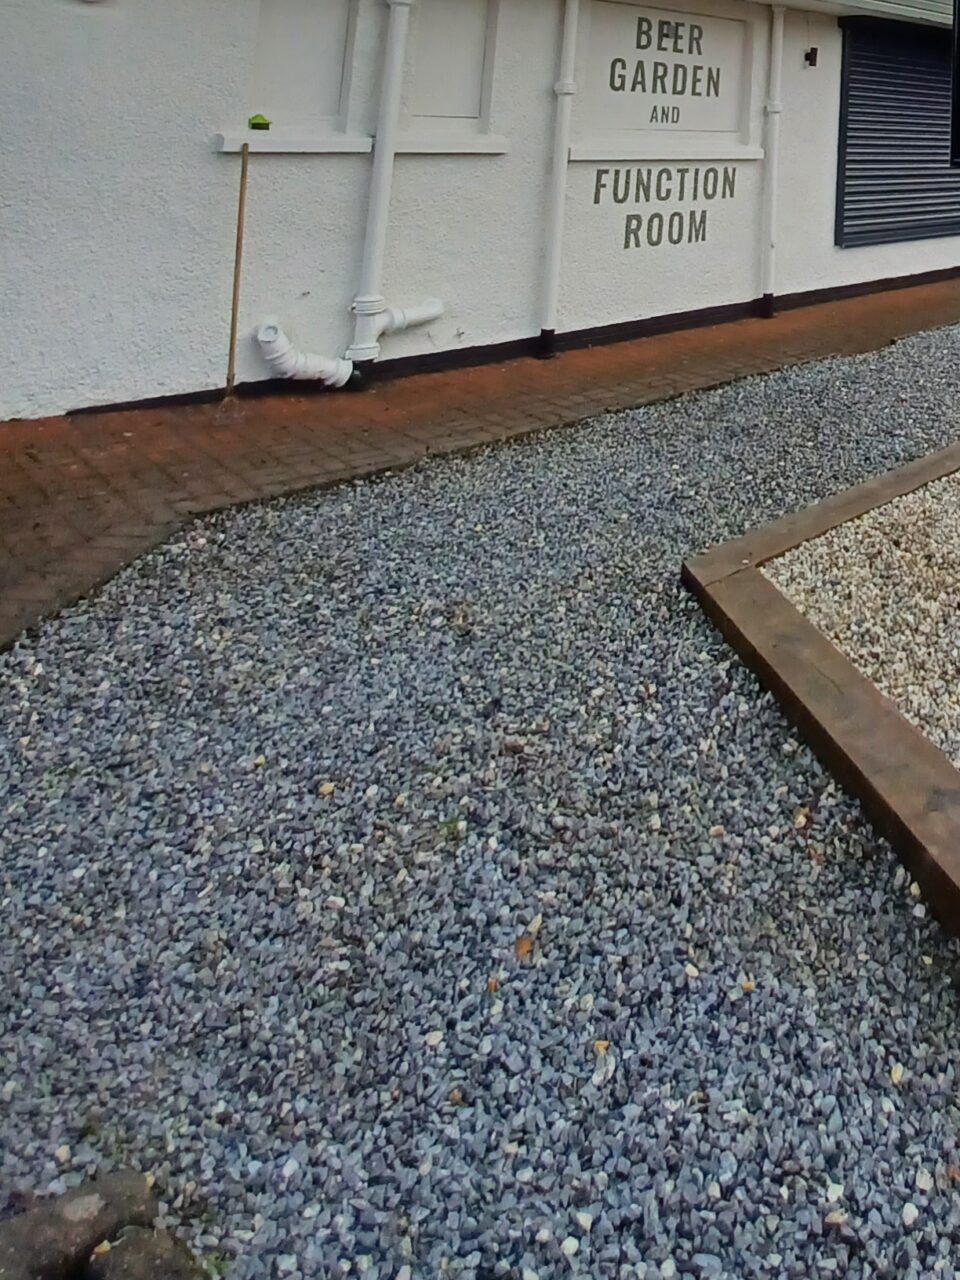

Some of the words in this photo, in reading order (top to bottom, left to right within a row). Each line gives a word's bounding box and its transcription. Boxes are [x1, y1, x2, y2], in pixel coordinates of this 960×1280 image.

[636, 17, 703, 55] BEER
[609, 58, 720, 97] GARDEN
[650, 105, 680, 124] AND
[593, 168, 736, 204] FUNCTION
[624, 210, 706, 248] ROOM
